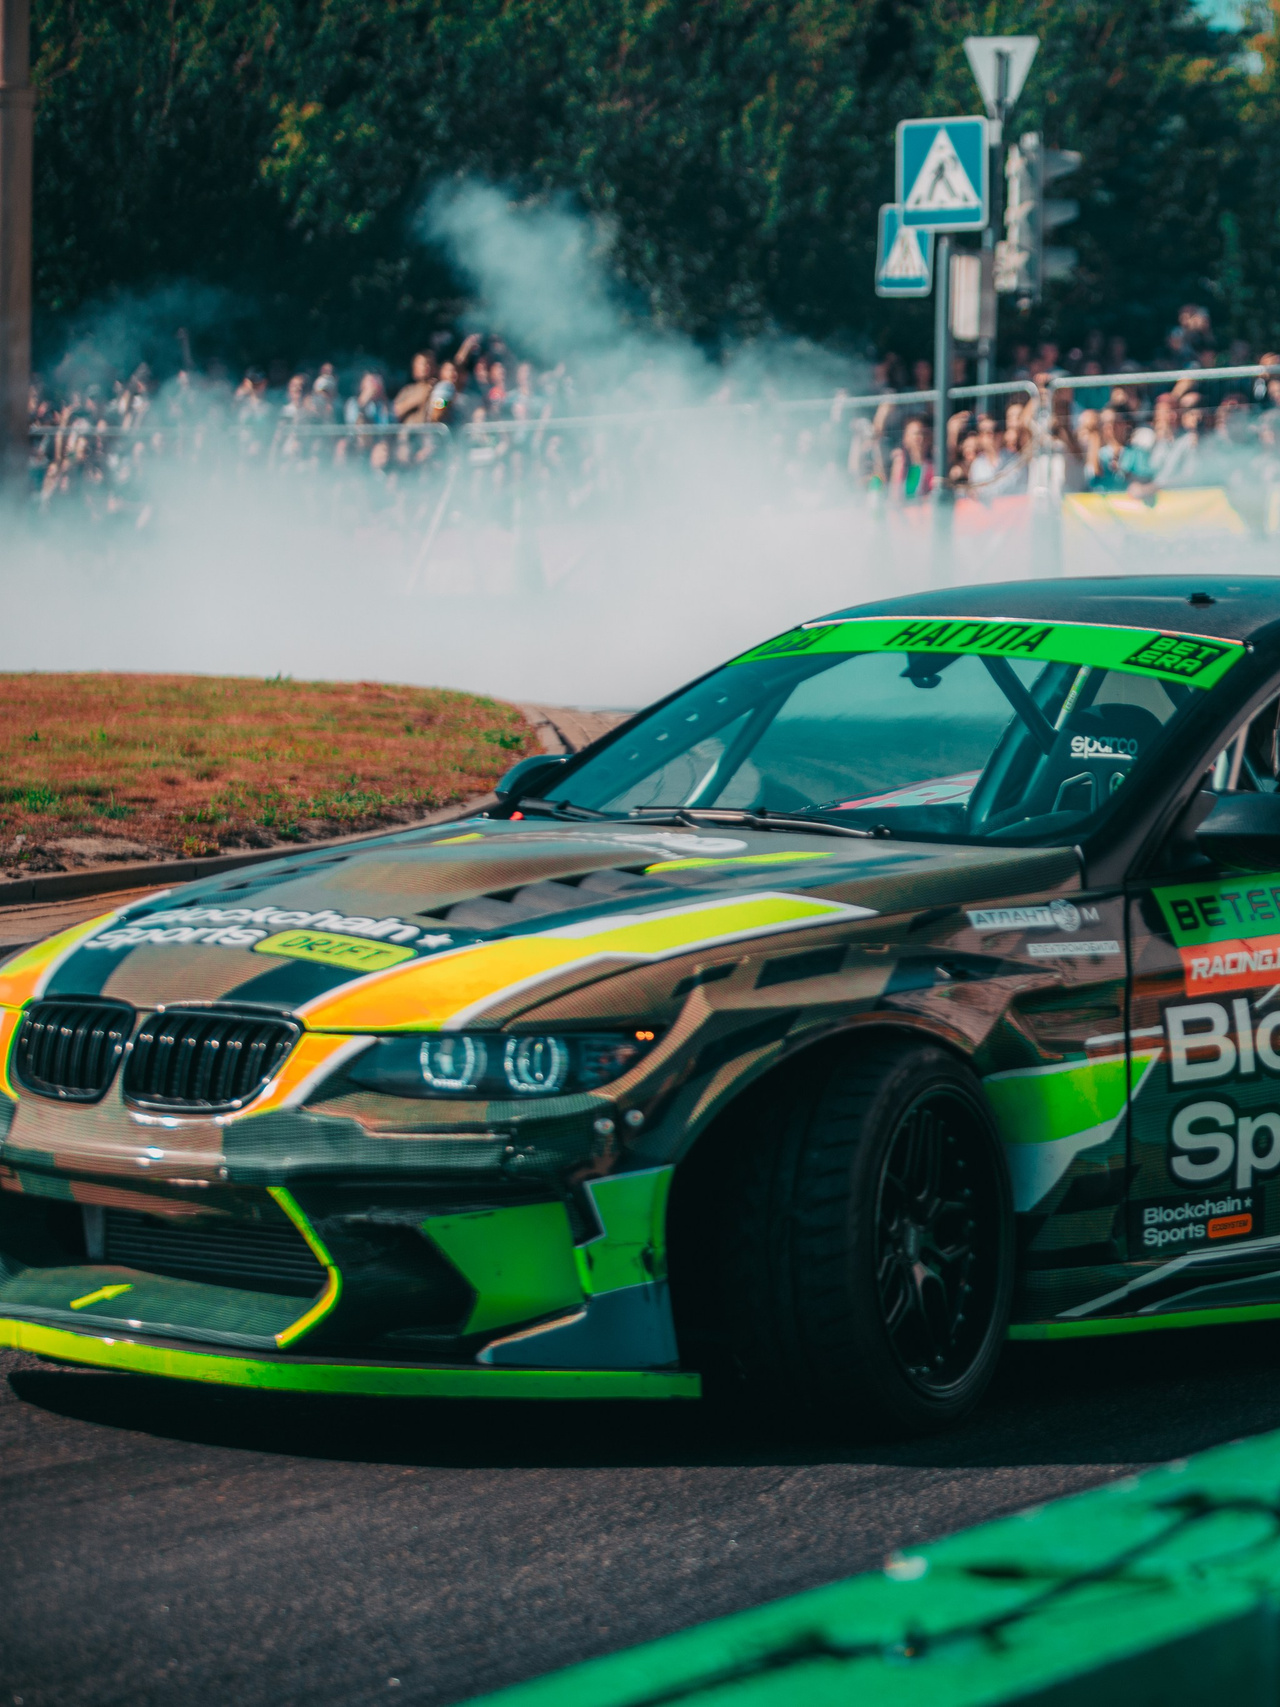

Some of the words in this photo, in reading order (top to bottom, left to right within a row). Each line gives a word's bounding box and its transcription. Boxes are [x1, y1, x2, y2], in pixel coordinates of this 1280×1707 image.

[883, 621, 1055, 653] НАГУЛА
[1149, 636, 1220, 660] BET
[1070, 735, 1139, 760] sparco
[126, 906, 421, 943] Blockchain
[975, 908, 1050, 925] АТЛАНТ
[278, 935, 393, 961] DRIFT
[1143, 1196, 1243, 1225] Blockchain
[1143, 1222, 1207, 1248] Sports
